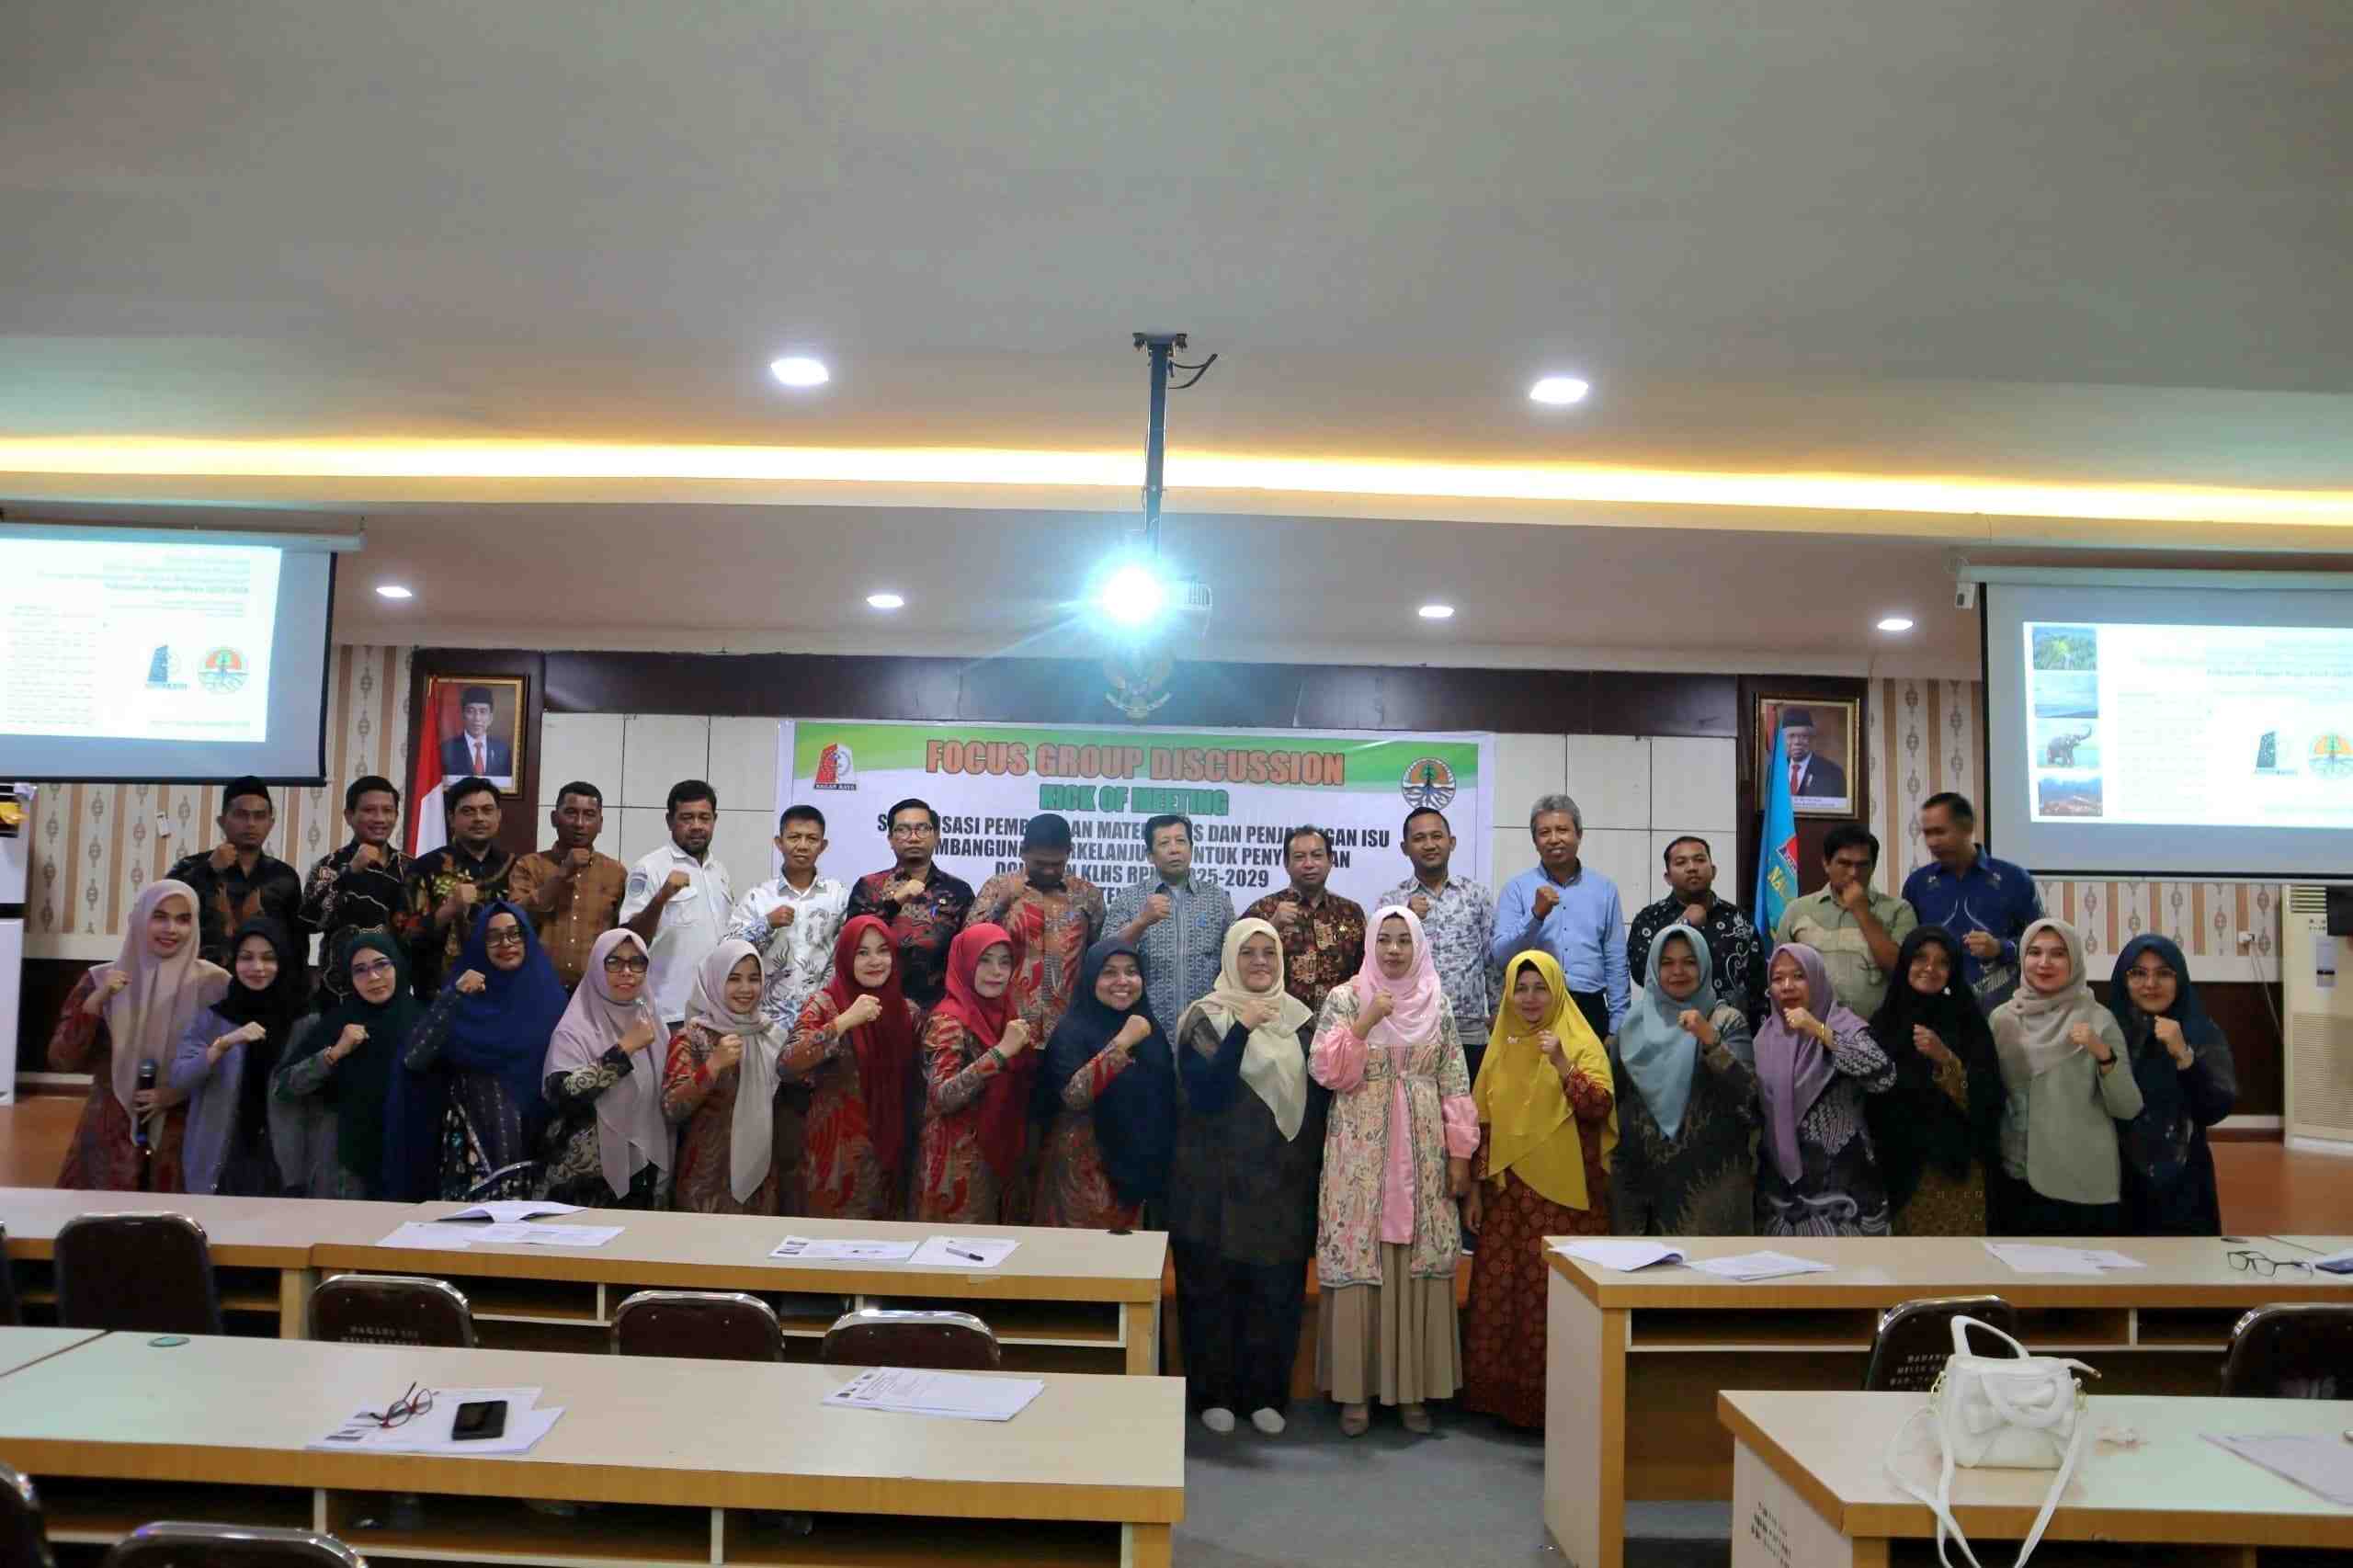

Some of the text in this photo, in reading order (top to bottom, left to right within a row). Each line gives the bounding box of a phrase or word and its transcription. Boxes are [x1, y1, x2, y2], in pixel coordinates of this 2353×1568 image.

[926, 739, 1346, 786] FOCUS GROUP DISCUSSION
[1040, 784, 1229, 816] KICK OF MEETING
[984, 817, 1093, 838] PEMBAN
[1209, 824, 1242, 843] DAN
[1361, 829, 1390, 847] ISU
[1194, 846, 1237, 864] NTUK
[1242, 847, 1350, 869] PENYAN
[1080, 864, 1123, 883] KLHS
[1191, 868, 1268, 888] 25-2029
